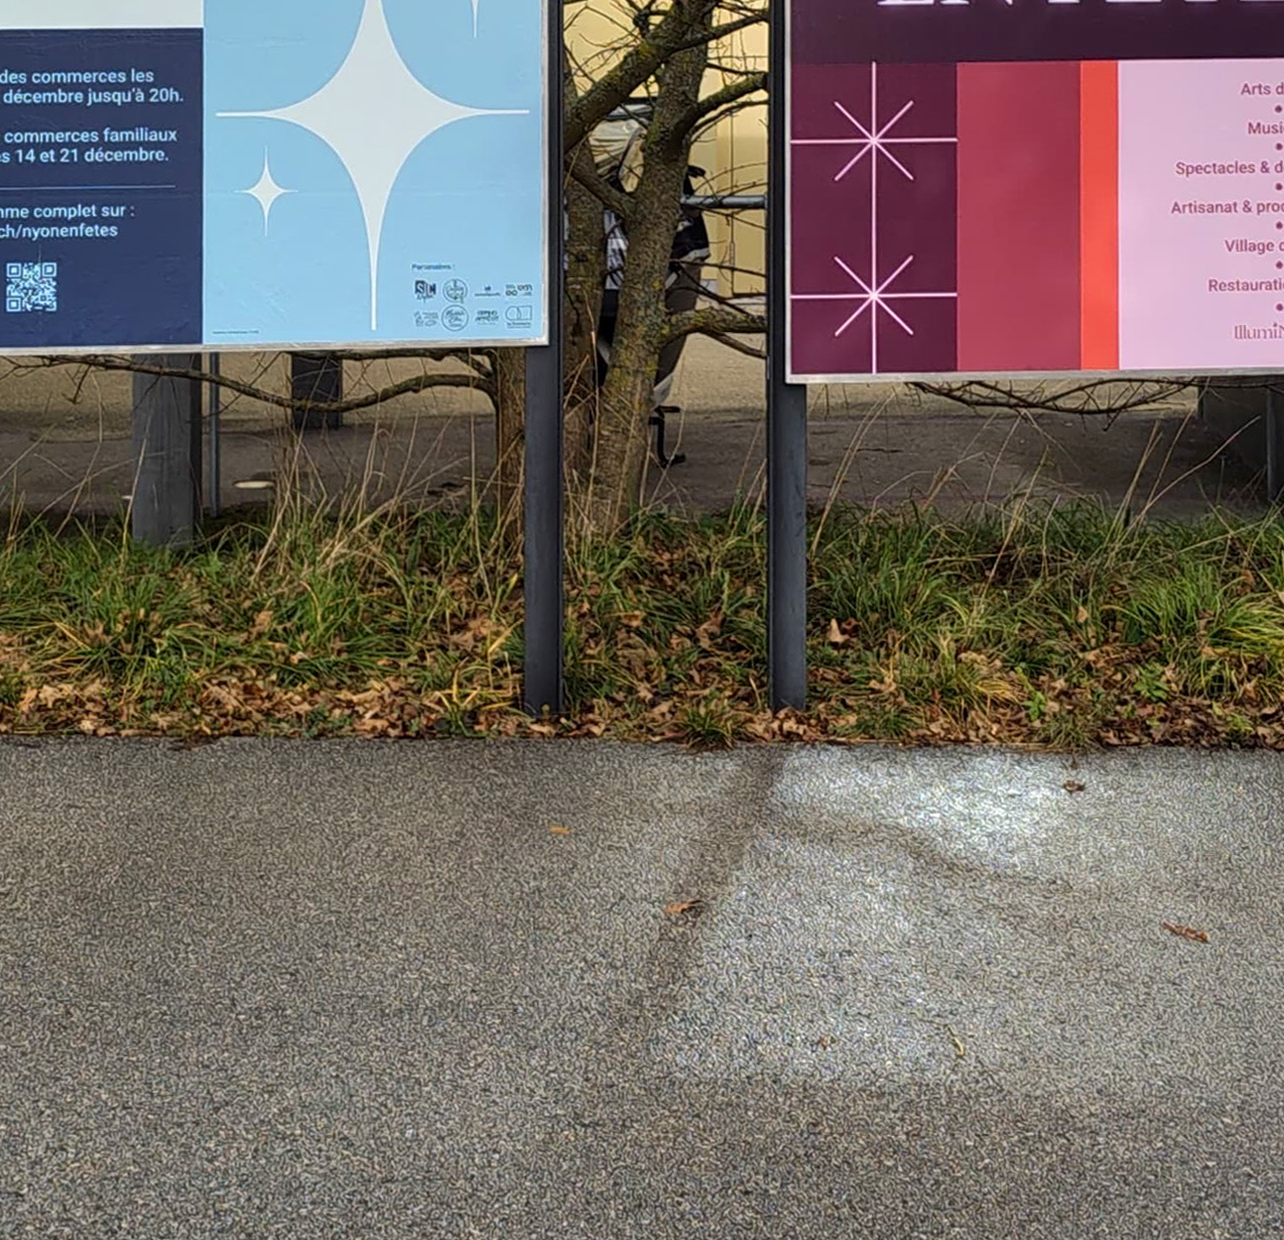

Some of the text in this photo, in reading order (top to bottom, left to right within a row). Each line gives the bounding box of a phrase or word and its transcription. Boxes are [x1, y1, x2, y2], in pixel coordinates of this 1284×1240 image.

[32, 72, 126, 83] commerces
[131, 68, 153, 82] les
[3, 89, 83, 103] décembre
[87, 88, 144, 106] jusqu'à
[149, 88, 183, 102] 20h.
[1241, 83, 1271, 95] Arts
[4, 132, 99, 143] commerces
[103, 127, 177, 142] familiaux
[16, 149, 35, 162] 14
[40, 150, 55, 162] et
[60, 148, 77, 162] 21
[84, 147, 168, 162] décembre.
[1176, 161, 1255, 177] Spectacles
[1260, 161, 1269, 173] &
[34, 204, 97, 220] complet
[102, 206, 125, 216] sur
[1171, 201, 1238, 213] Artisanat
[1243, 200, 1252, 213] &
[1225, 239, 1274, 255] Village
